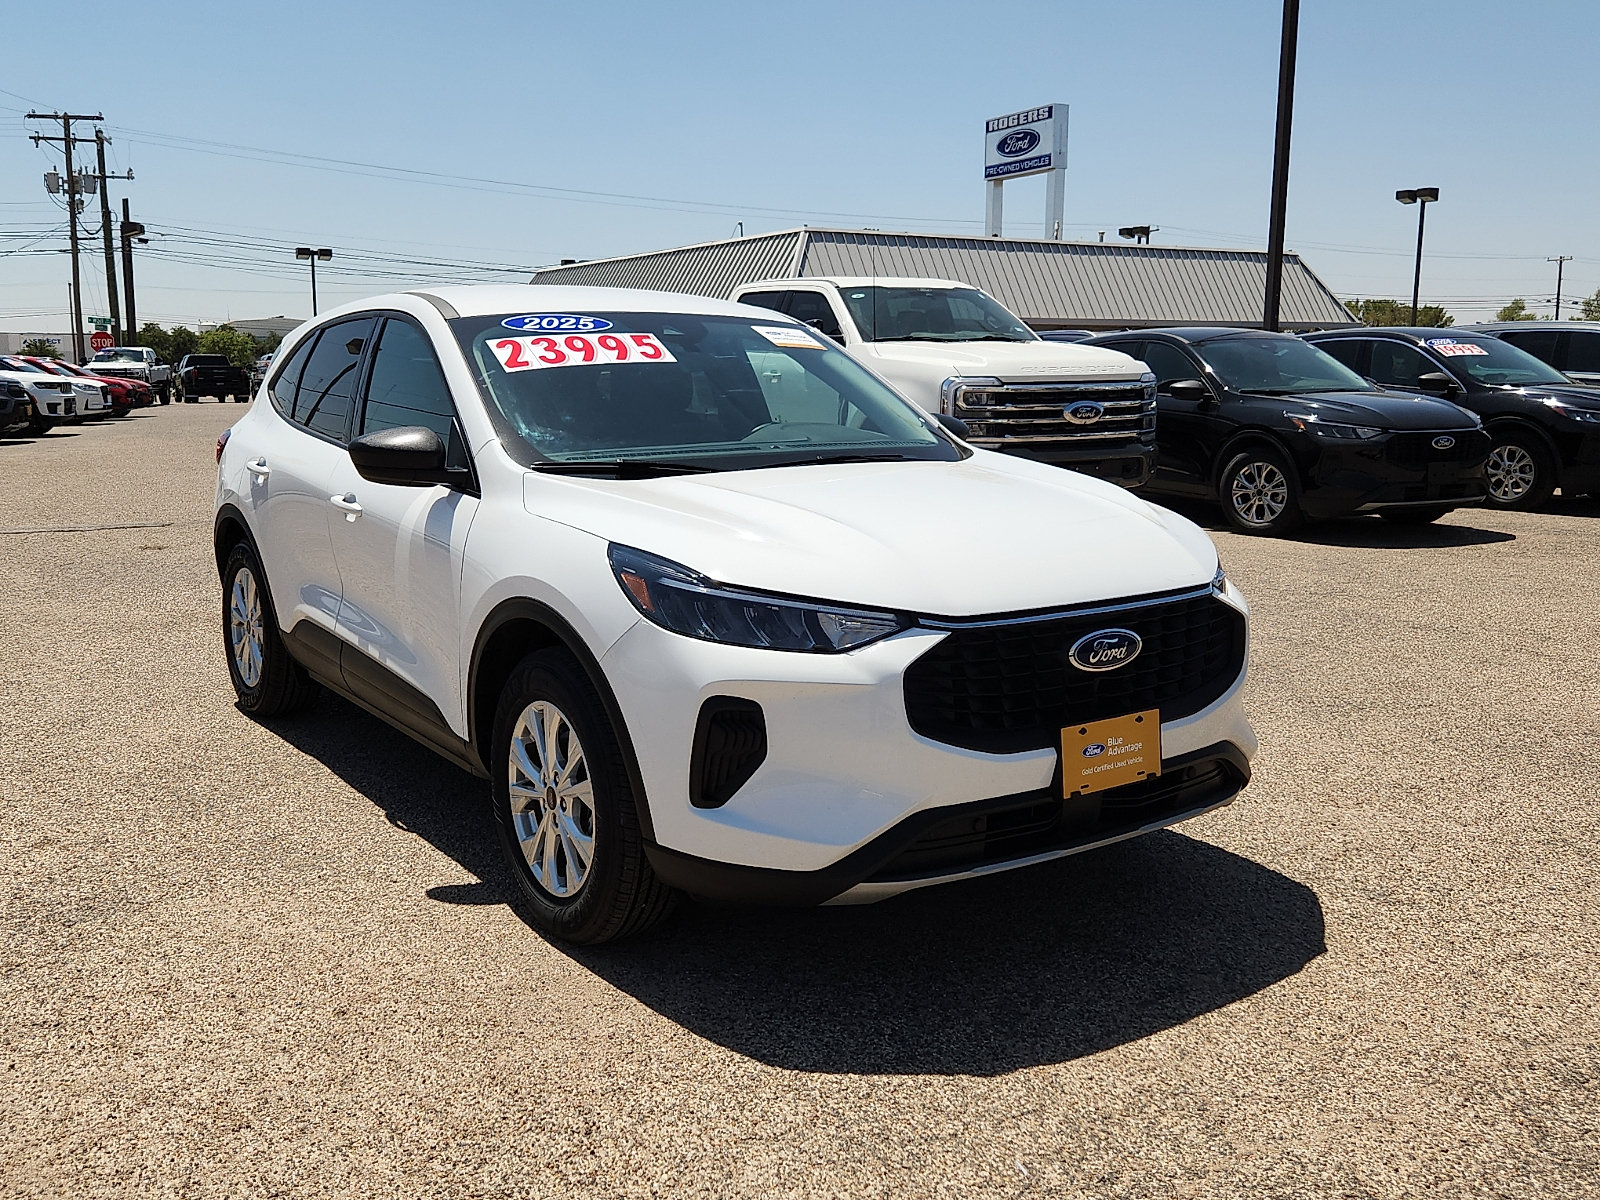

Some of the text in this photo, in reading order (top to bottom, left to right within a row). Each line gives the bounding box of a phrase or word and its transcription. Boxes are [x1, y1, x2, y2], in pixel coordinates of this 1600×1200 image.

[988, 107, 1049, 132] ROGERS
[1004, 133, 1031, 153] Ford
[986, 157, 1050, 176] PRE-OWNED VEHICLES
[523, 317, 595, 330] 2025
[91, 338, 113, 348] STOP
[1436, 345, 1485, 355] 19995
[496, 335, 667, 369] 23995
[1076, 406, 1096, 418] Ford
[1089, 638, 1129, 663] Ford
[1107, 736, 1123, 747] Blue
[1085, 745, 1102, 756] Ford
[1107, 742, 1143, 757] Advantage
[1081, 756, 1144, 776] Gold Certified Used Vehicle
